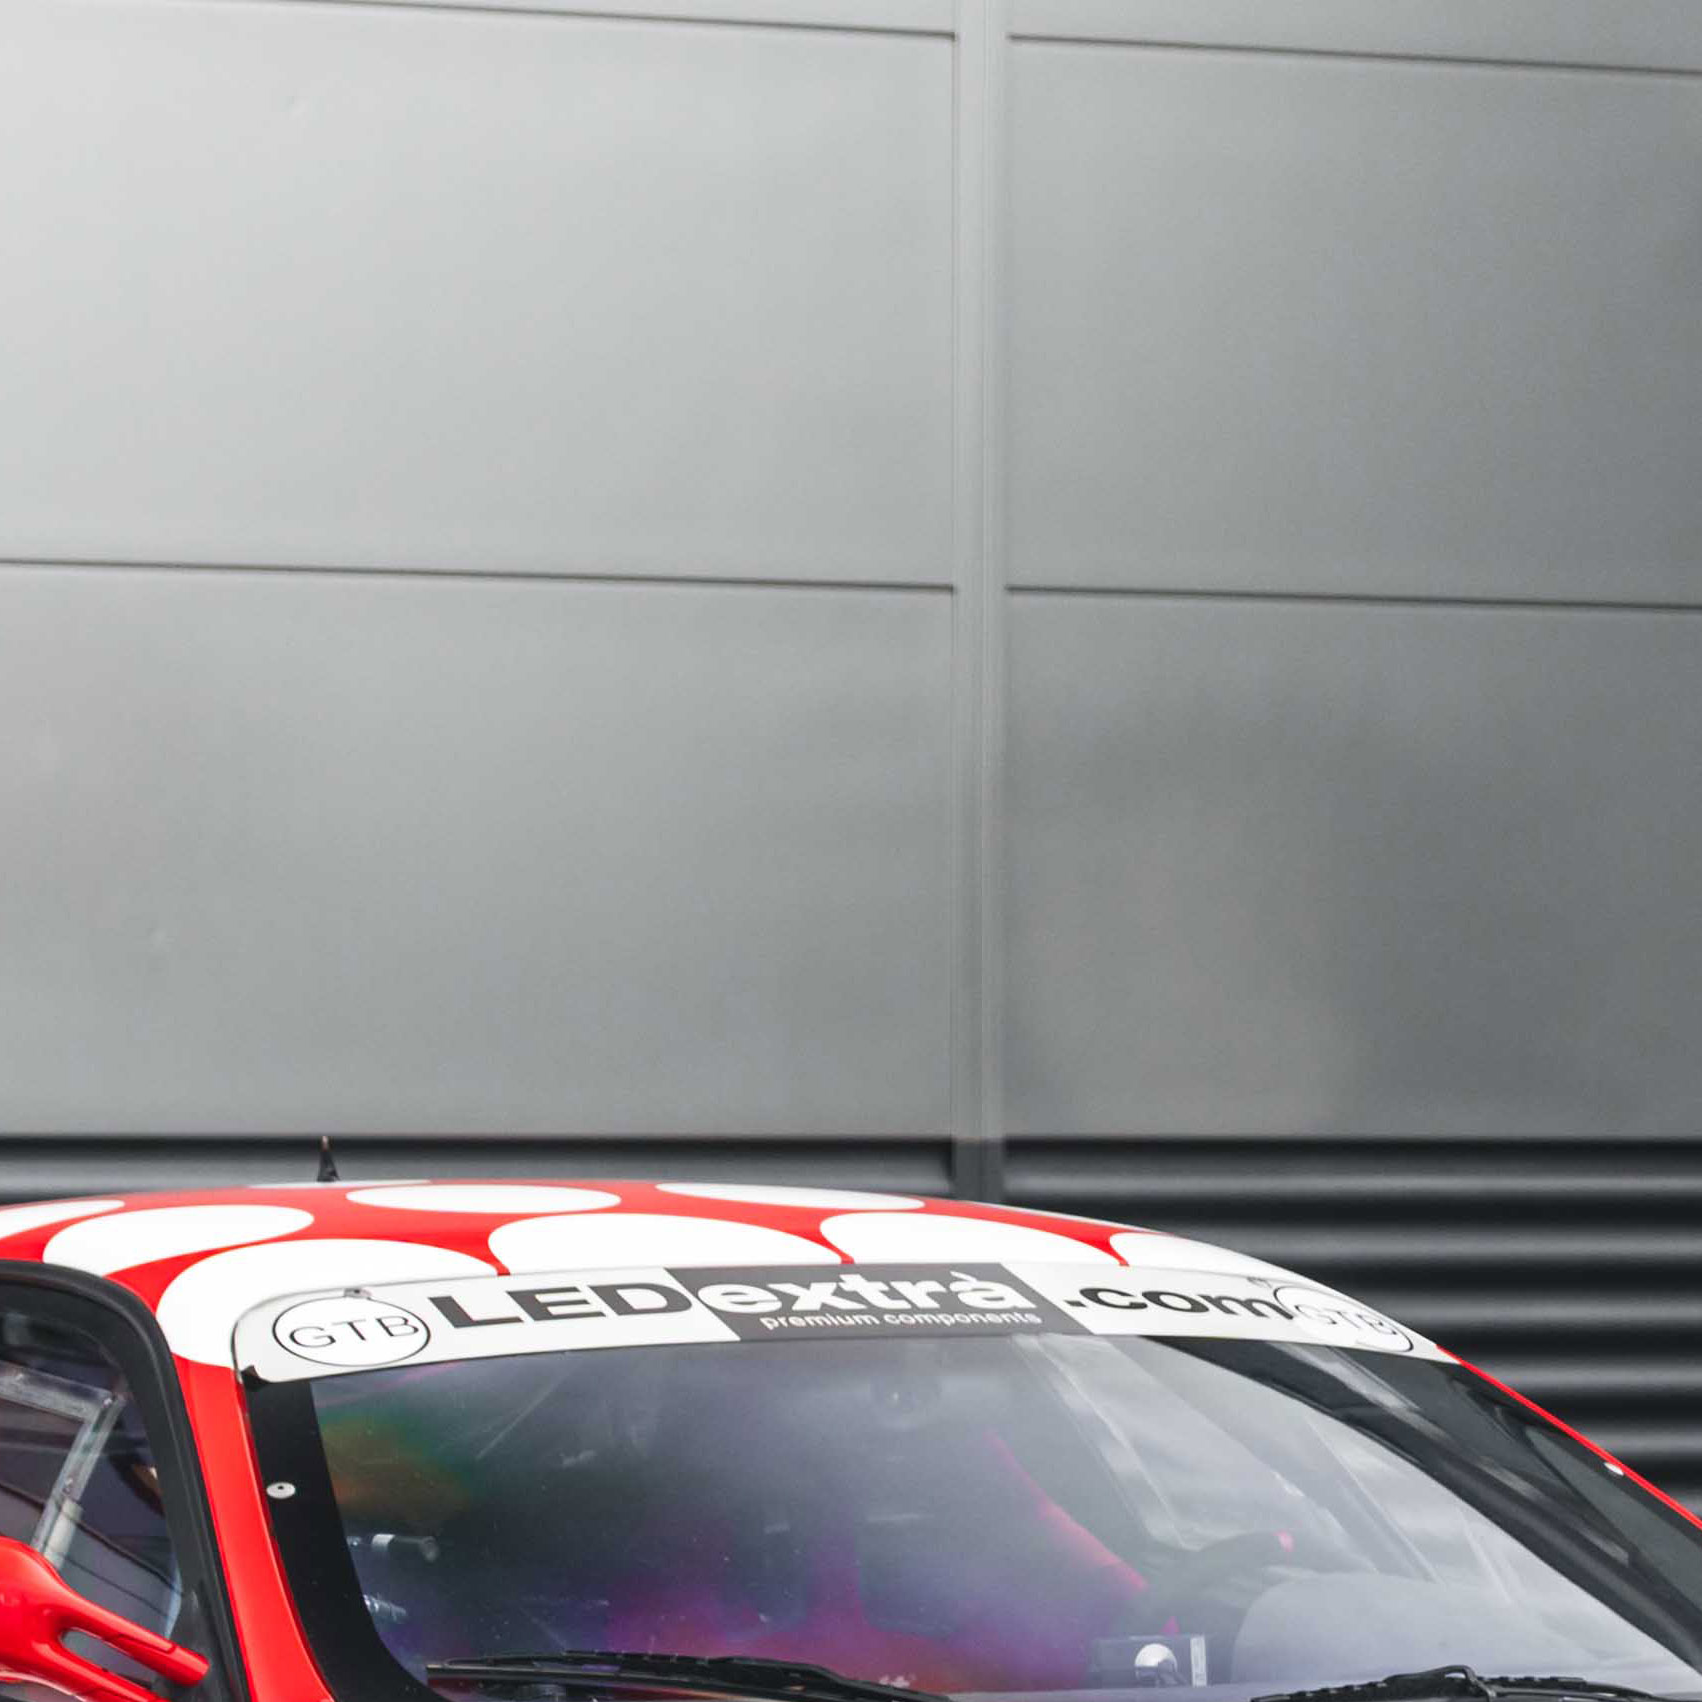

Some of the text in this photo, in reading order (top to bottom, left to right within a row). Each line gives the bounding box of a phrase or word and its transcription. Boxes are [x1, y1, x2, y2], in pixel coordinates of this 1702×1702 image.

[289, 1315, 419, 1349] GTB
[761, 1312, 1043, 1332] premium components
